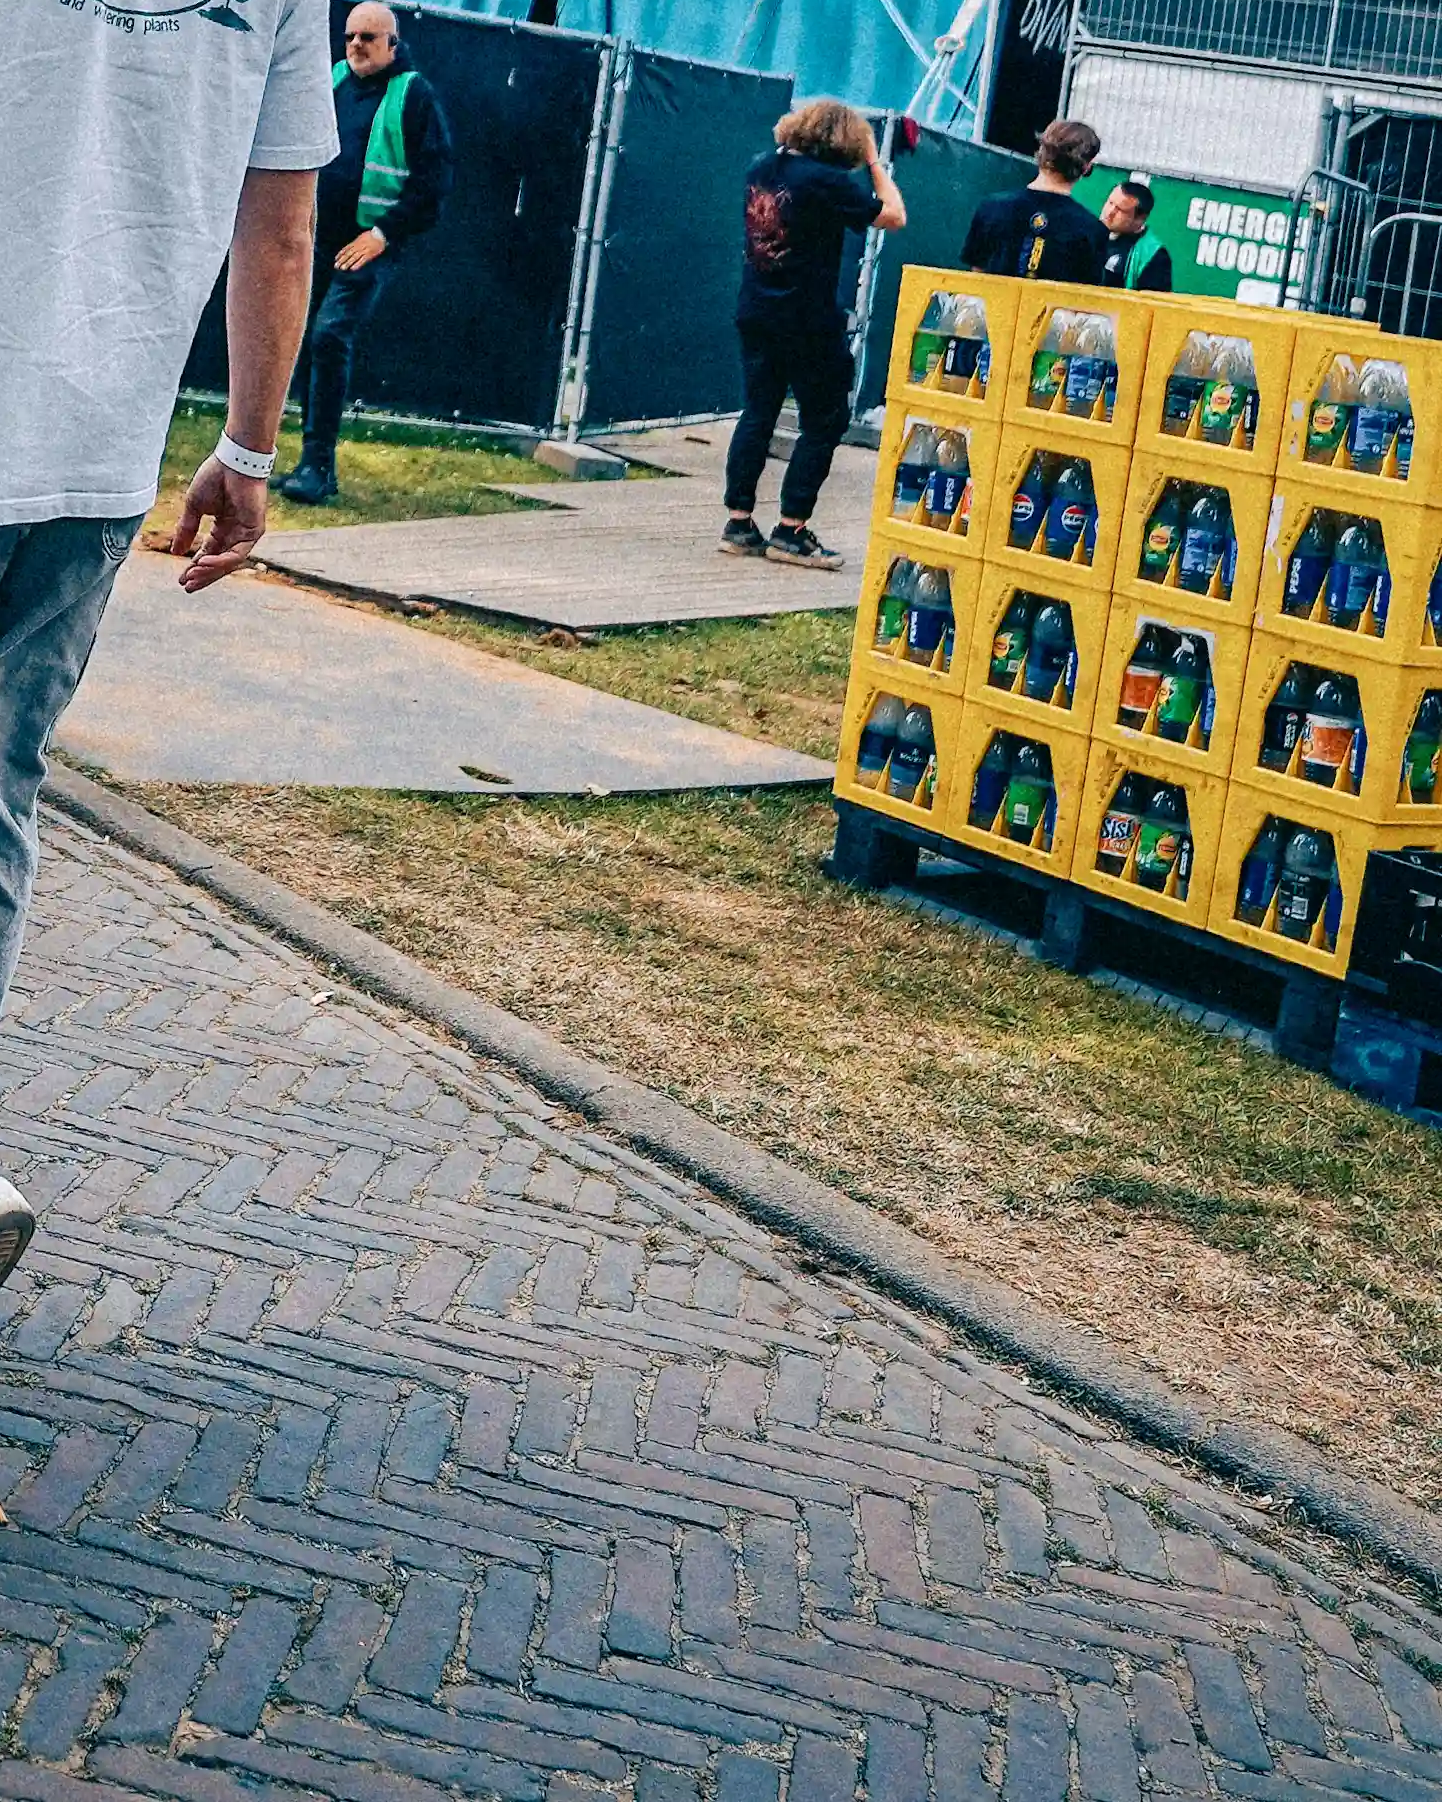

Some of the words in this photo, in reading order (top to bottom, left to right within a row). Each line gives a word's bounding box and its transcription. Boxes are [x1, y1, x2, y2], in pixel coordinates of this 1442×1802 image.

[94, 4, 135, 33] wtering
[143, 17, 180, 35] plants
[1289, 557, 1302, 594] PEPSI
